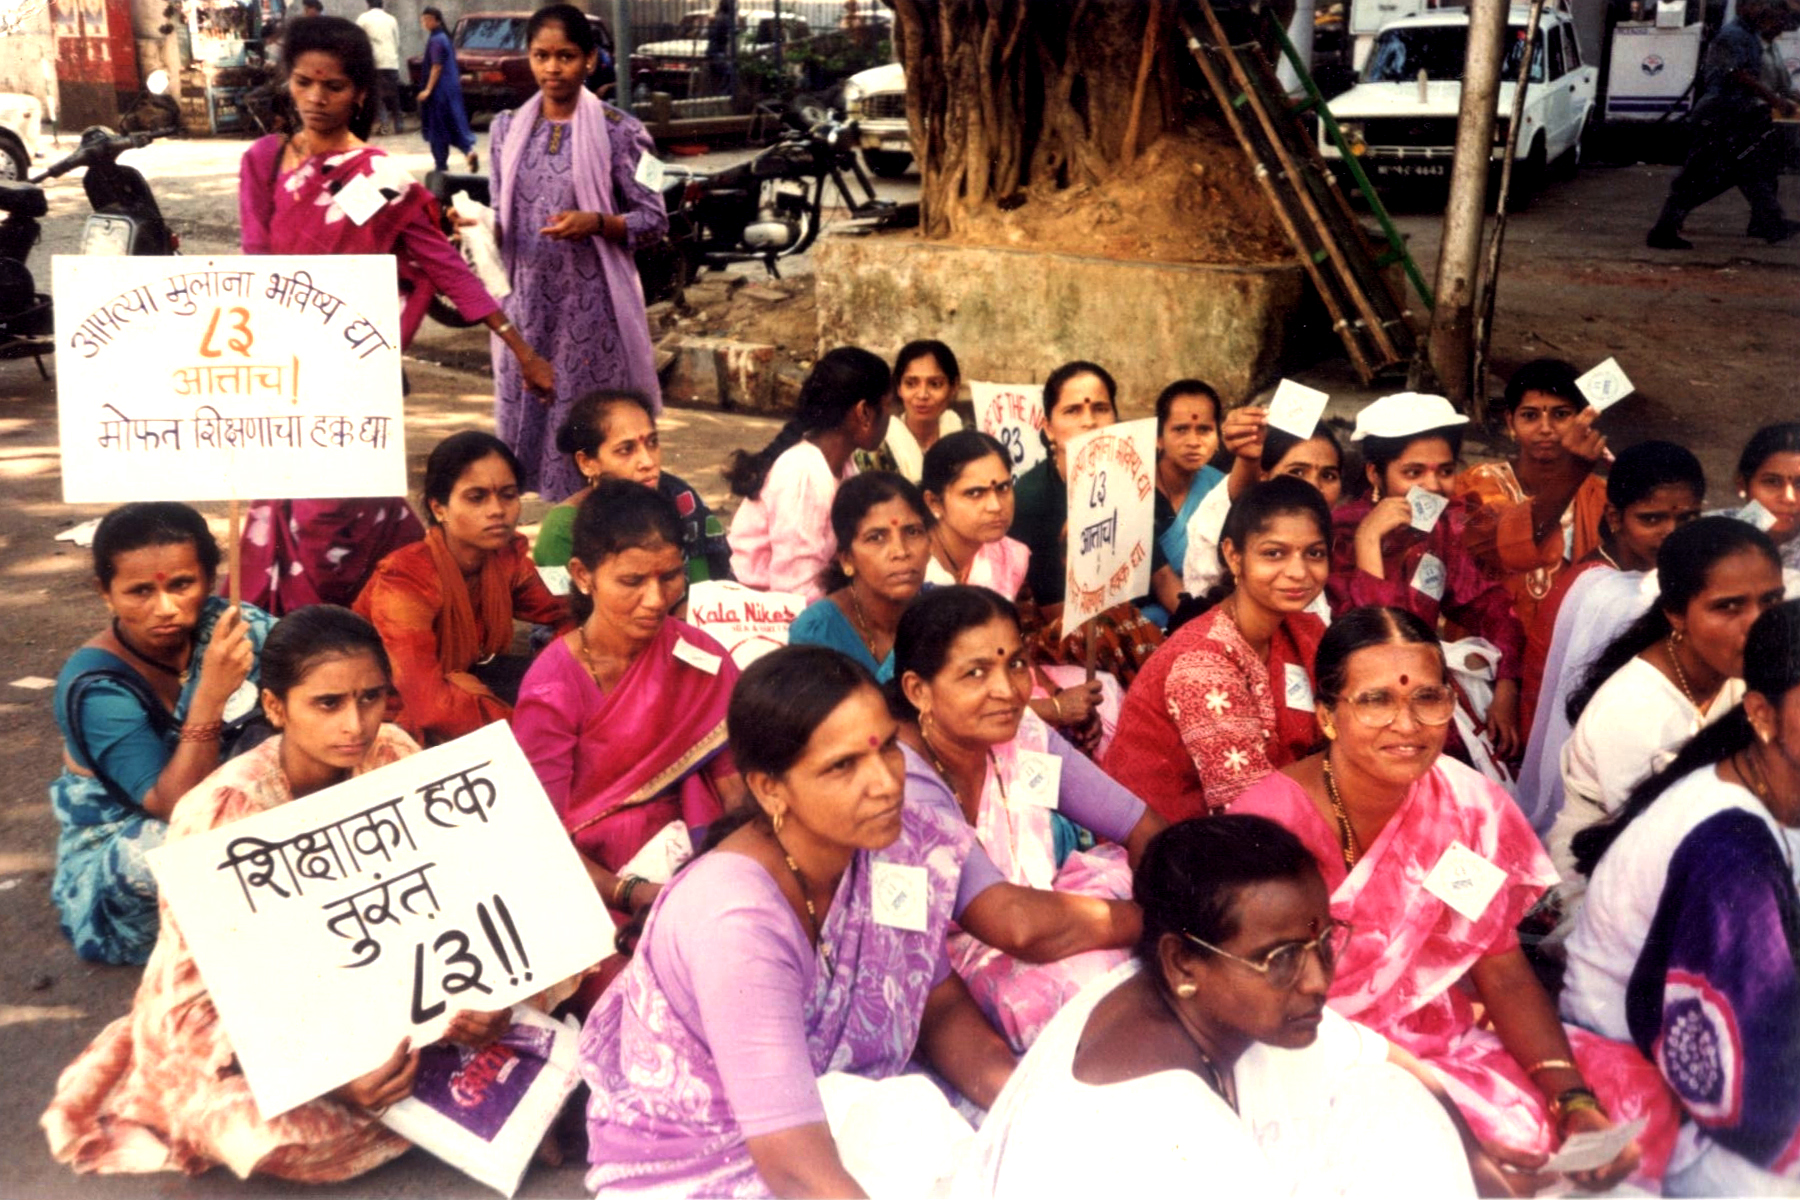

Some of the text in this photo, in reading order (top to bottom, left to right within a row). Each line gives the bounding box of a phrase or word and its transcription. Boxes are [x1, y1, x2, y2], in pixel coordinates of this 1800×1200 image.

[166, 261, 255, 316] मुलांना
[265, 271, 347, 325] भविष्य
[199, 307, 254, 358] ८३
[98, 403, 183, 450] मोफत
[191, 405, 304, 448] शिक्षणाचा
[310, 415, 354, 448] हक्क
[1004, 392, 1027, 423] THE
[1089, 470, 1107, 508] ८३
[692, 601, 741, 628] Kala
[216, 760, 497, 913] शिक्षाका हक
[410, 894, 533, 1025] ८३!!
